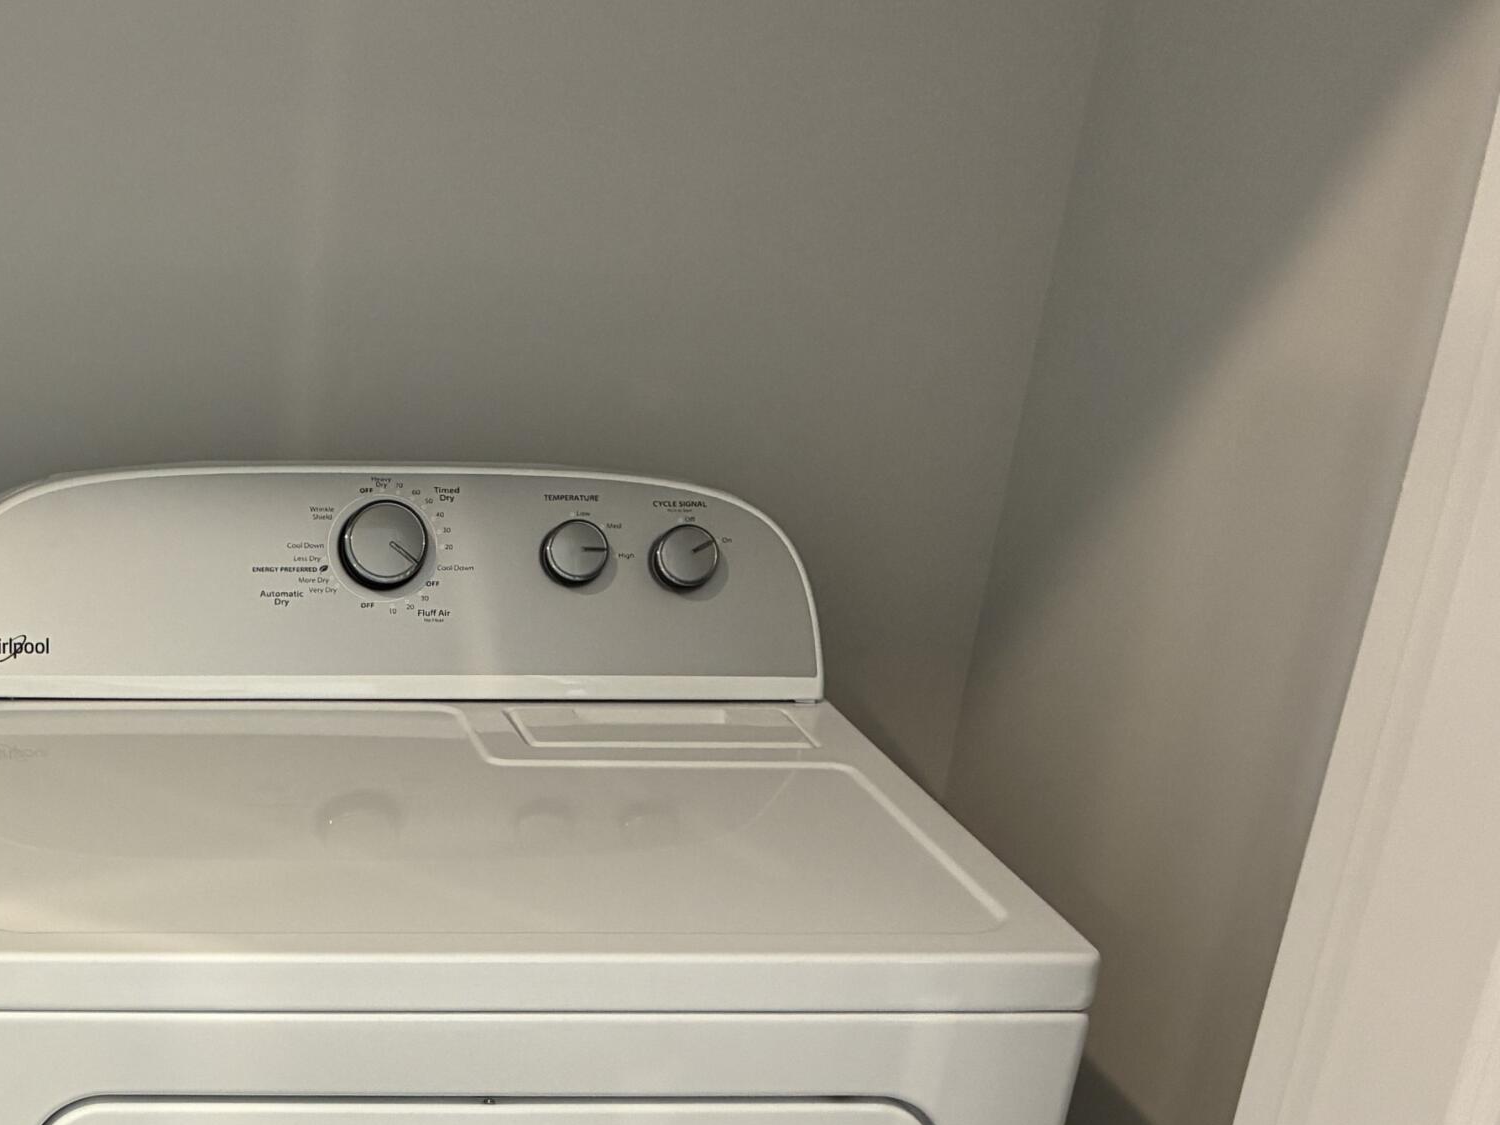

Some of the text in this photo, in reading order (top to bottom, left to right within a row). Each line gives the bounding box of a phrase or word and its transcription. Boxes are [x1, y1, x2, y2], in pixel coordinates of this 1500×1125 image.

[434, 486, 460, 494] Timed
[439, 494, 455, 502] Dry
[544, 494, 599, 502] TEMPERATURE
[309, 555, 321, 563] Dry
[618, 552, 635, 560] High
[316, 577, 330, 585] Dry
[260, 590, 304, 598] Automatic
[309, 587, 338, 595] Very Dry
[274, 598, 290, 607] Dry
[417, 609, 450, 617] Fluff Air
